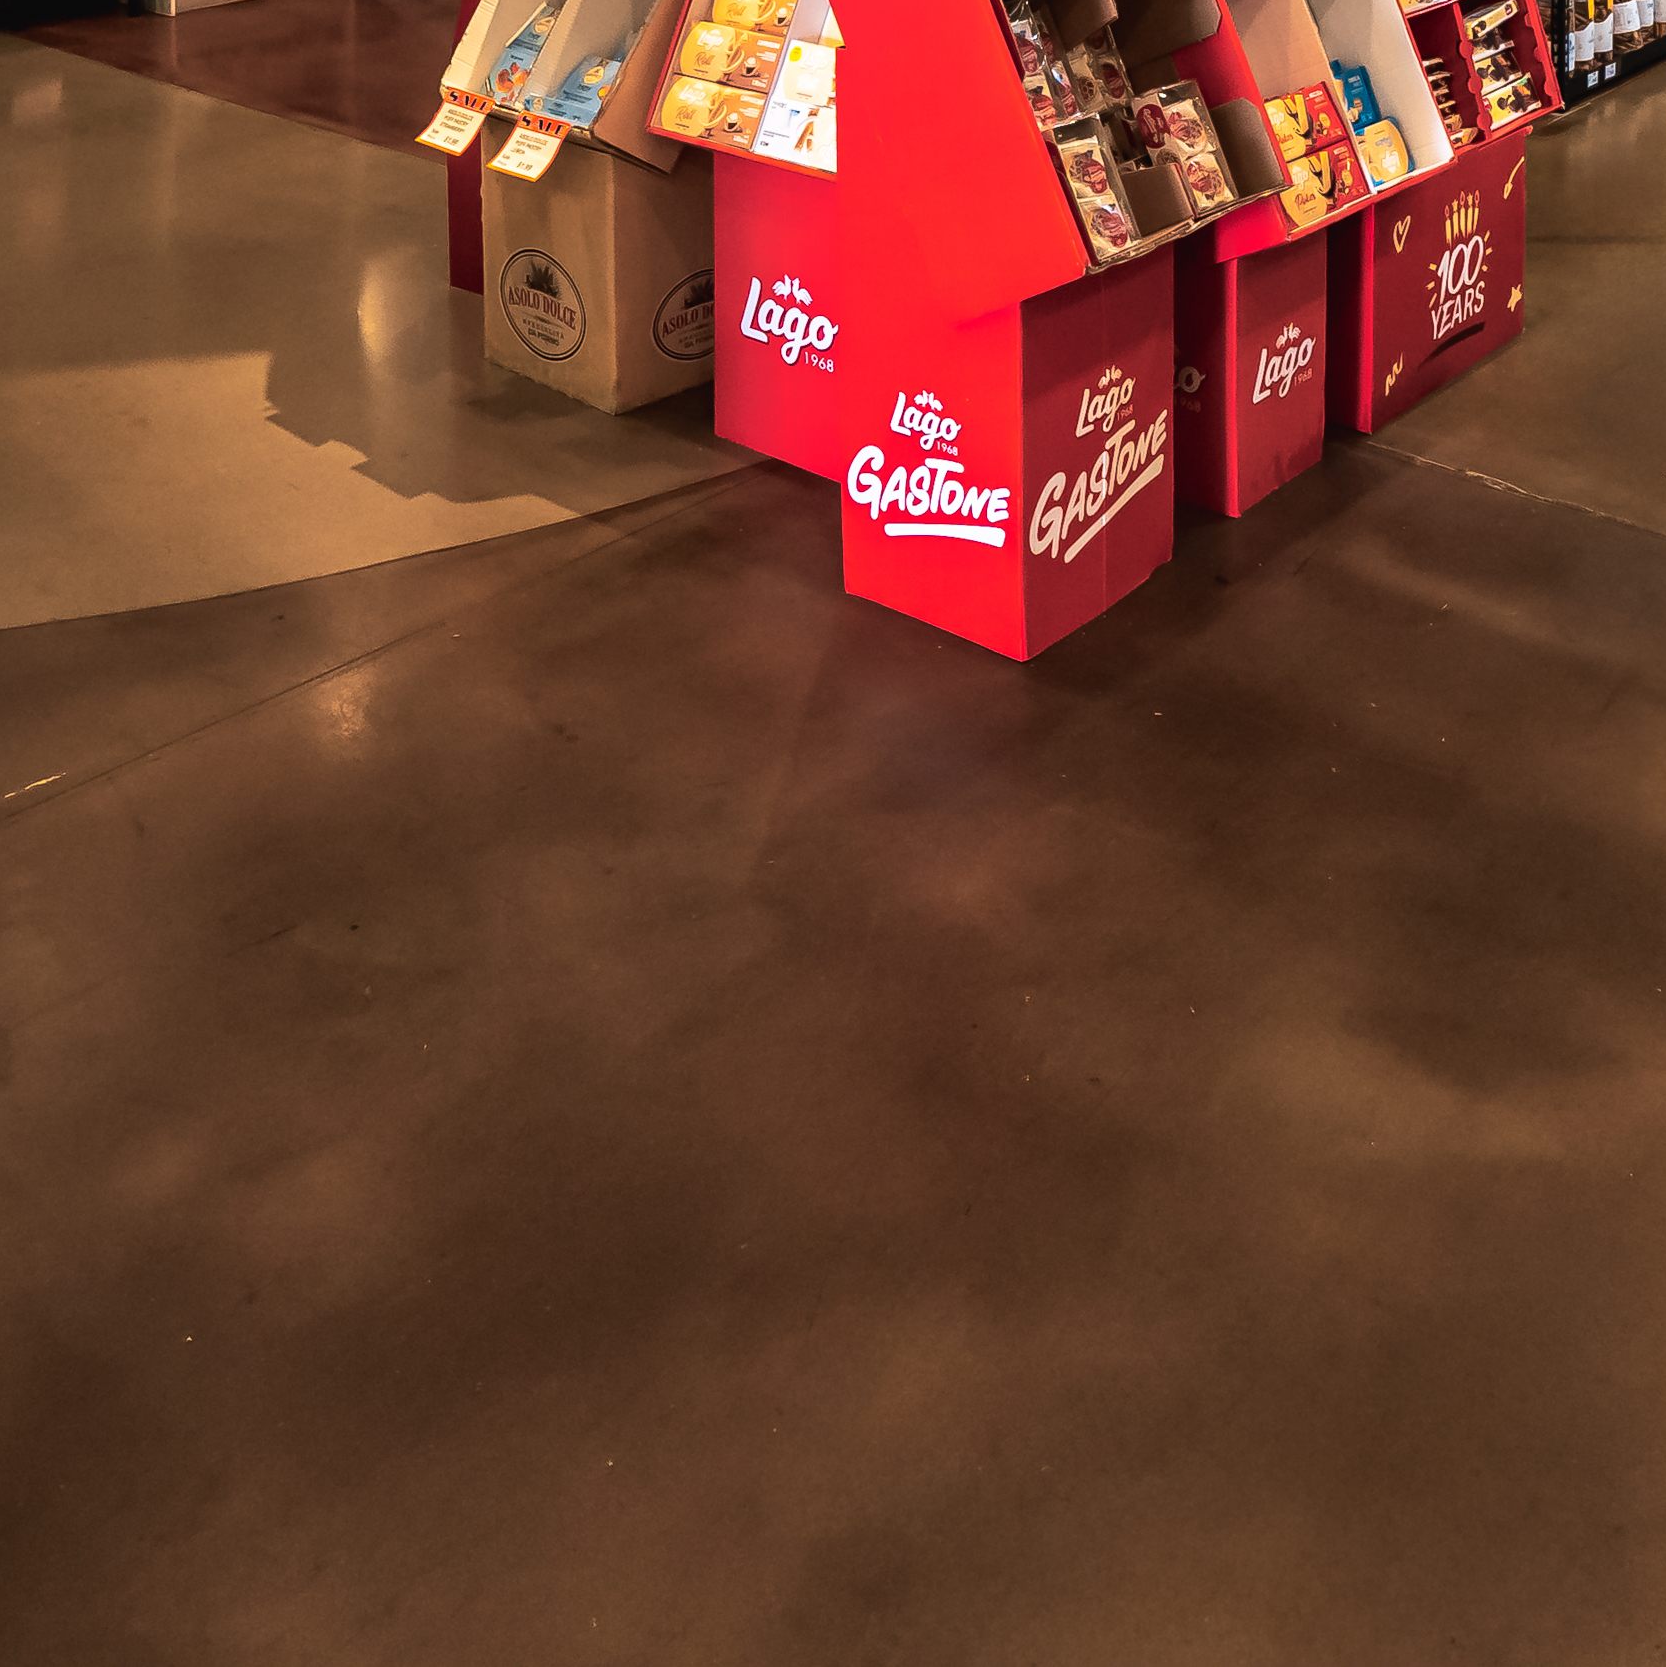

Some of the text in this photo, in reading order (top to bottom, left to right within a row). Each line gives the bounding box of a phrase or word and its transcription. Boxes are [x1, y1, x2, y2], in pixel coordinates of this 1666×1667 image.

[1435, 234, 1485, 303] 100
[509, 286, 576, 332] ASOLO DOLCE
[740, 276, 838, 365] Lago
[1430, 279, 1485, 341] YEARS
[803, 353, 834, 373] 1968
[1253, 335, 1316, 404] Lago
[890, 392, 961, 450] Lago
[1077, 374, 1135, 438] Lago
[936, 442, 959, 456] 1968
[847, 444, 1011, 524] GASTONE
[1029, 409, 1168, 557] GASTONE
